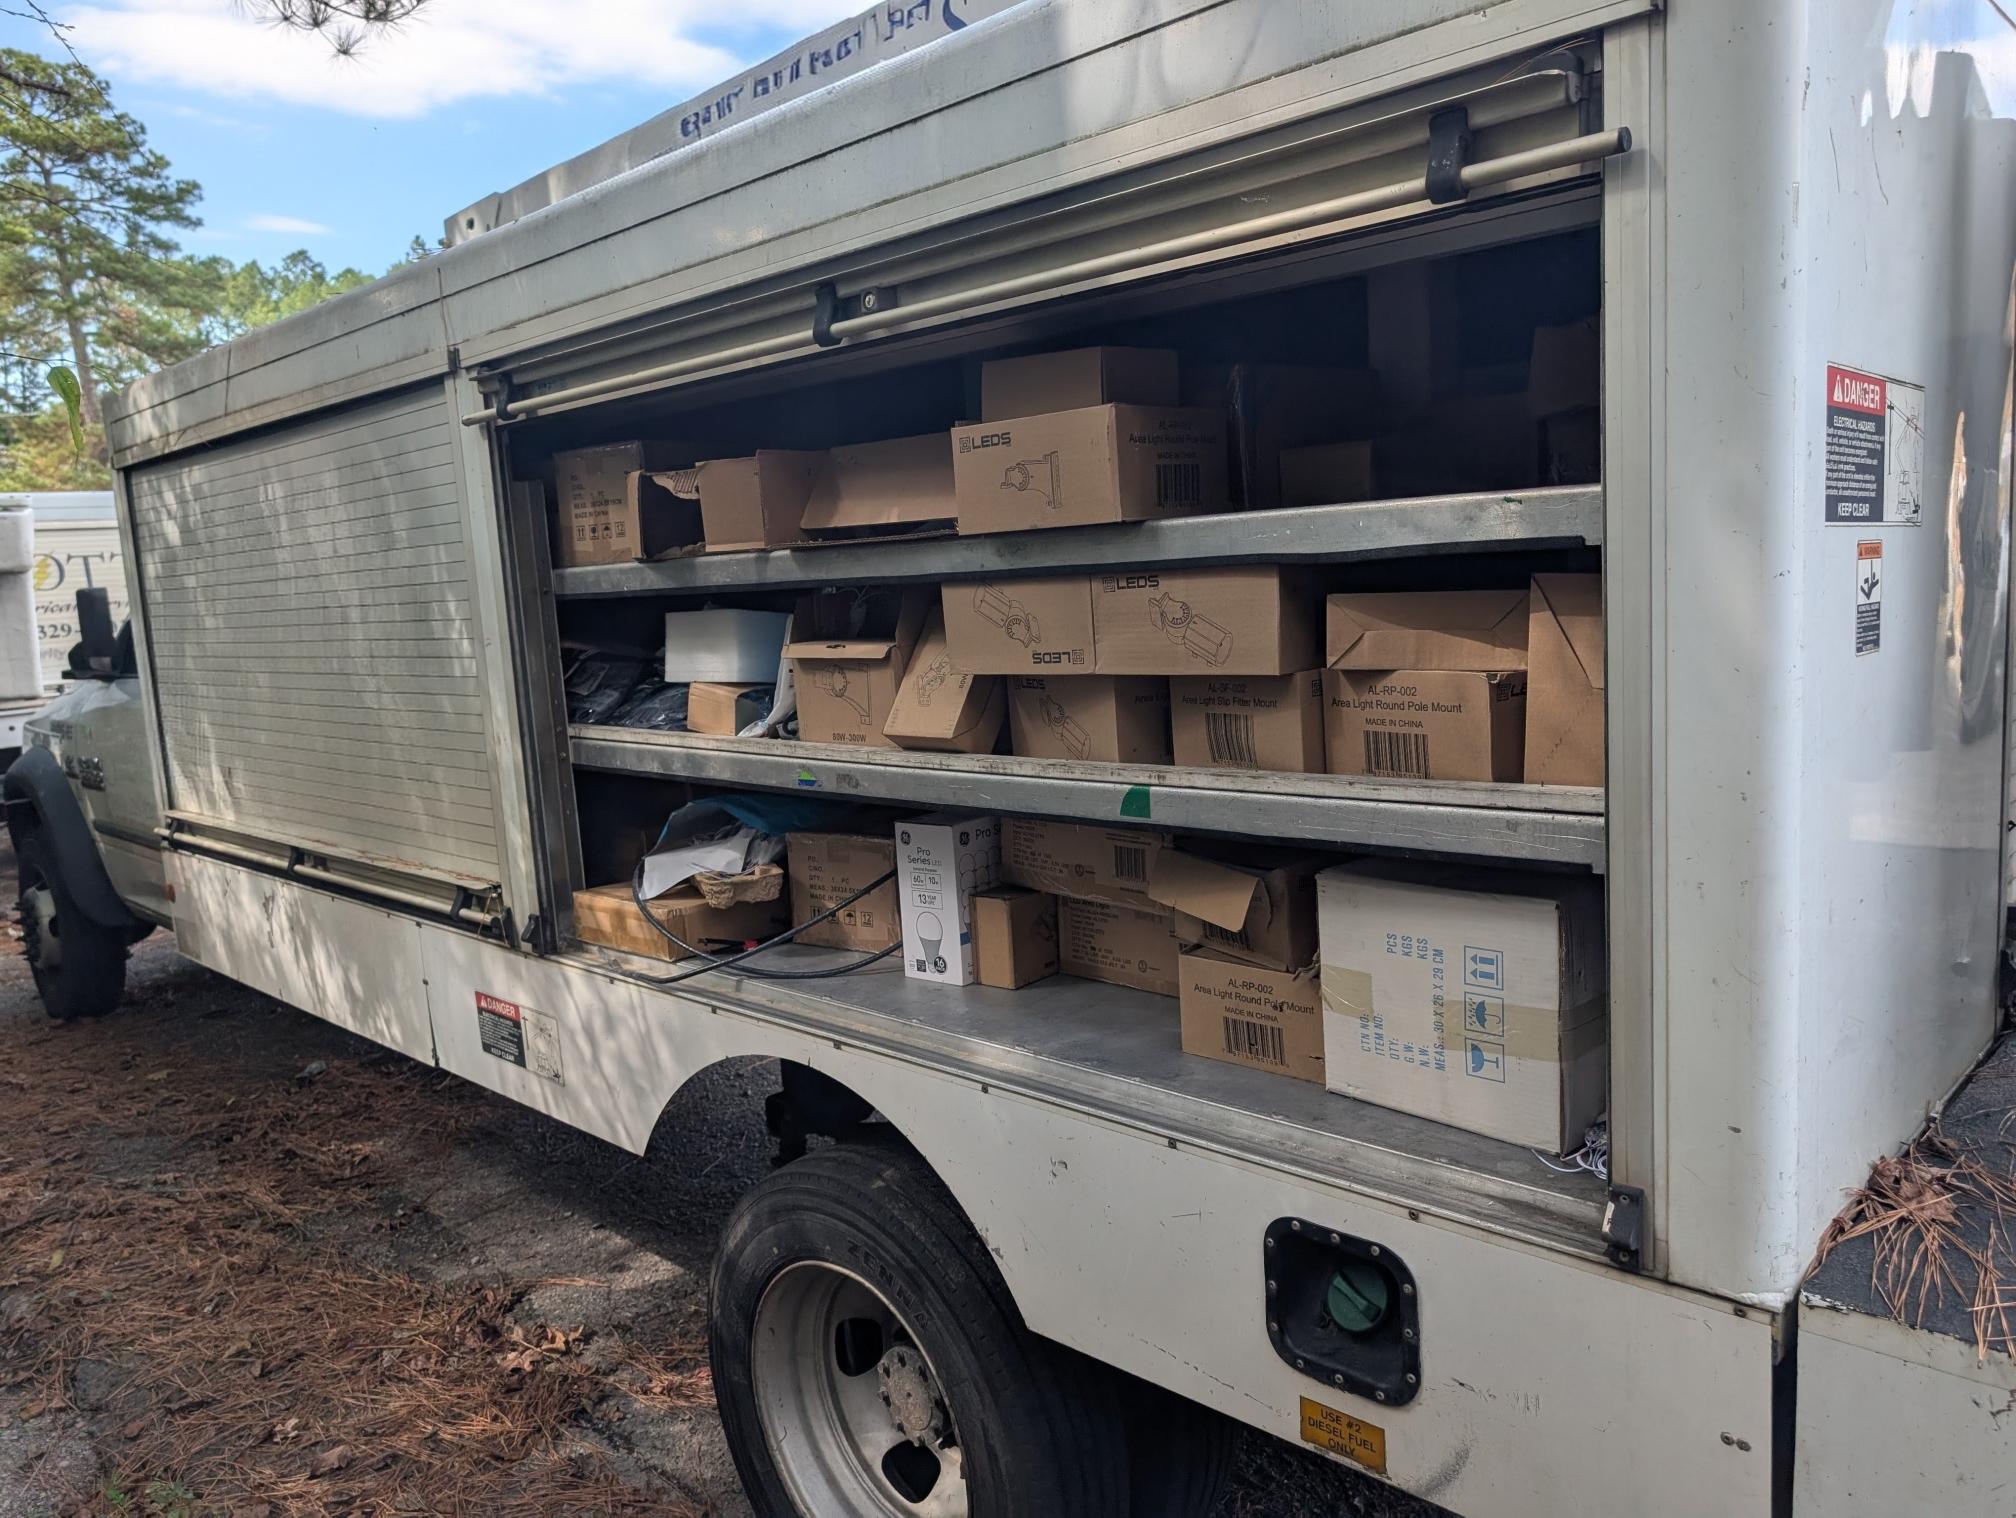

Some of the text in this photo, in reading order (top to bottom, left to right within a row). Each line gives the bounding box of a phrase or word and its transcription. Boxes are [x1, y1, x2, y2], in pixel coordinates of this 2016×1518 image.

[1844, 378, 1880, 409] DANGER
[1833, 415, 1857, 429] ELECTRICAL
[972, 432, 1012, 450] LEDS
[1838, 503, 1870, 517] KEEP CLEAR
[1117, 575, 1160, 590] LEDS
[1032, 652, 1071, 665] LEDS
[1020, 678, 1045, 690] LEDS
[1367, 685, 1417, 697] AL-RP-002
[1182, 695, 1278, 708] Area Light Slip Fitter Mount
[1331, 698, 1462, 714] Area Light Round Pole Mount
[1365, 717, 1423, 729] MADE IN CHINA
[975, 828, 991, 841] Pro
[916, 846, 931, 857] Pro
[907, 855, 931, 866] Series
[809, 892, 826, 900] MADE
[917, 893, 927, 905] 13
[863, 914, 872, 922] 12
[935, 957, 945, 968] 16
[1433, 949, 1444, 964] CM
[1433, 968, 1444, 981] 29
[1228, 978, 1274, 995] AL-RP-002
[1194, 984, 1212, 995] Area
[1213, 987, 1233, 1000] Light
[1234, 991, 1262, 1006] Round
[1287, 1001, 1315, 1015] Mount
[1387, 933, 1400, 1060] QTY: PCS
[1401, 935, 1415, 1064] G.W: KGS
[1417, 938, 1430, 1067] N.W: KGS
[1433, 995, 1444, 1007] 26
[487, 998, 516, 1018] DANGER
[1224, 1005, 1279, 1023] MADE IN CHINA
[1360, 1012, 1371, 1052] CTN NO:
[1434, 1022, 1444, 1032] 30
[1375, 1012, 1385, 1057] ITEM NO:
[1320, 1408, 1362, 1434] USE #2
[1308, 1417, 1376, 1453] DIESEL FUEL
[1328, 1439, 1356, 1456] ONLY
